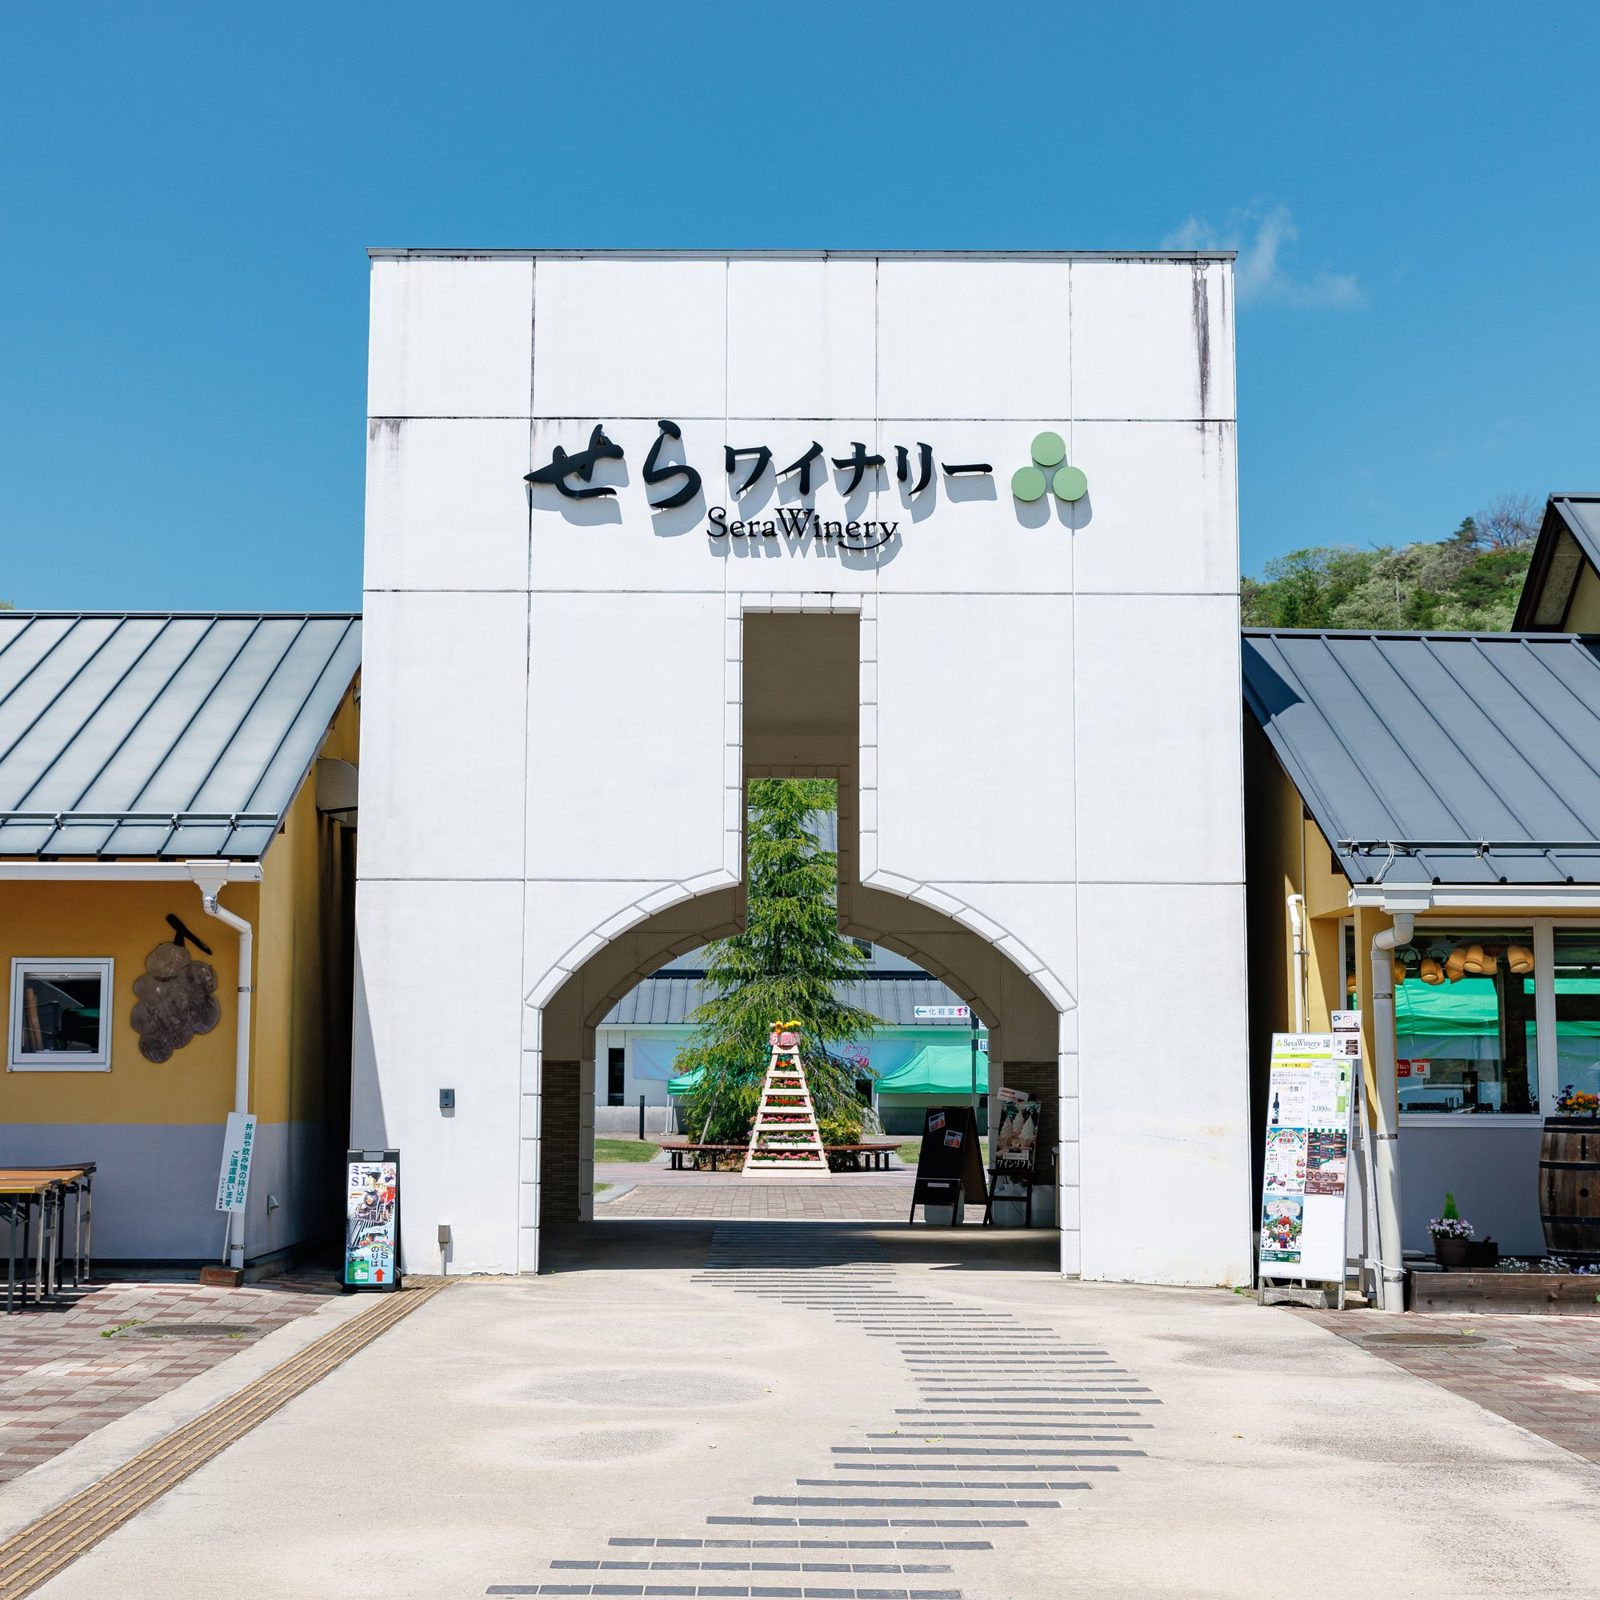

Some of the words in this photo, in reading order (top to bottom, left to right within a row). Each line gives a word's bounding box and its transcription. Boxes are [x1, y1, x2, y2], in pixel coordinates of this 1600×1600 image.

[524, 419, 992, 508] せらワイナリー
[707, 507, 898, 550] SeraWinery
[1283, 1038, 1321, 1049] SeraWinery
[224, 1150, 240, 1207] ご遠慮願います
[235, 1122, 253, 1204] 弁当や飲み物の持込は
[351, 1177, 370, 1187] SL
[997, 1159, 1033, 1169] ワインソフト
